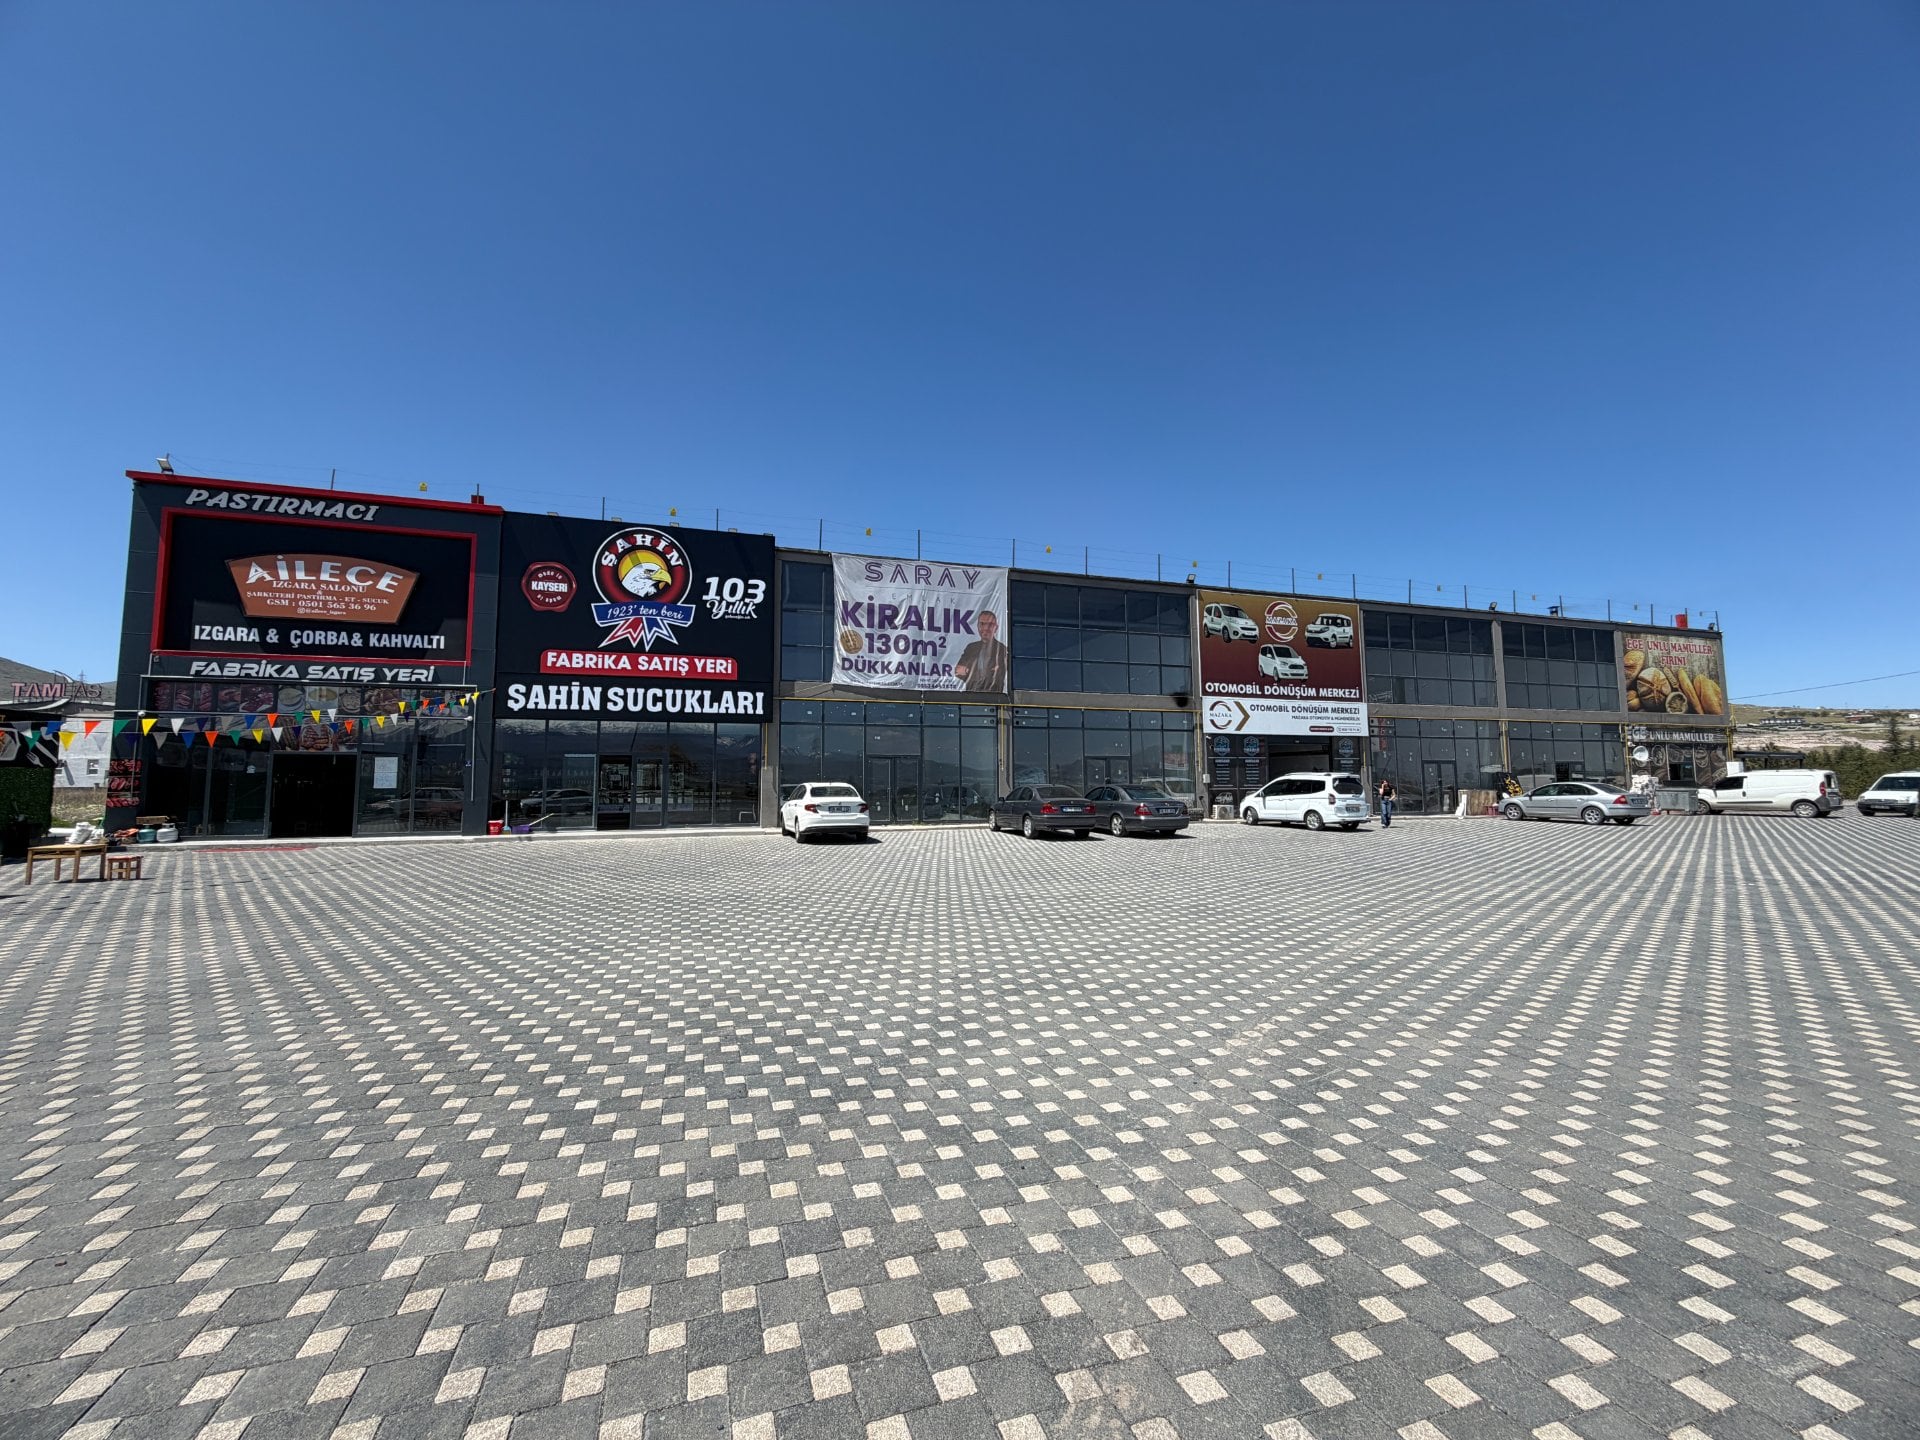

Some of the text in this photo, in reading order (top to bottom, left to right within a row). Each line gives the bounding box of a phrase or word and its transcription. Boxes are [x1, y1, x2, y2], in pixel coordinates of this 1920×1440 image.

[185, 489, 380, 521] PASTIRMACI
[245, 554, 404, 593] AİLECE
[864, 562, 981, 589] SARAY
[272, 580, 367, 593] IZGARA SALONU
[702, 576, 766, 604] 103
[639, 604, 658, 616] ten
[660, 606, 685, 620] beri
[841, 595, 976, 635] KİRALIK
[194, 625, 445, 650] IZGARA & ÇORBA & KAHVALTI
[1626, 638, 1645, 649] EGE
[189, 660, 435, 683] FABRİKA SATIŞ YERİ
[547, 652, 732, 676] FABRİKA SATIŞ YERİ
[841, 656, 953, 677] DÜKKANLAR
[507, 681, 764, 715] ŞAHİN SUCUKLARI
[1205, 682, 1360, 699] OTOMOBİL DÖNÜŞÜM MERKEZİ
[1249, 703, 1360, 716] OTOMOBİL DÖNÜŞÜM MERKEZİ
